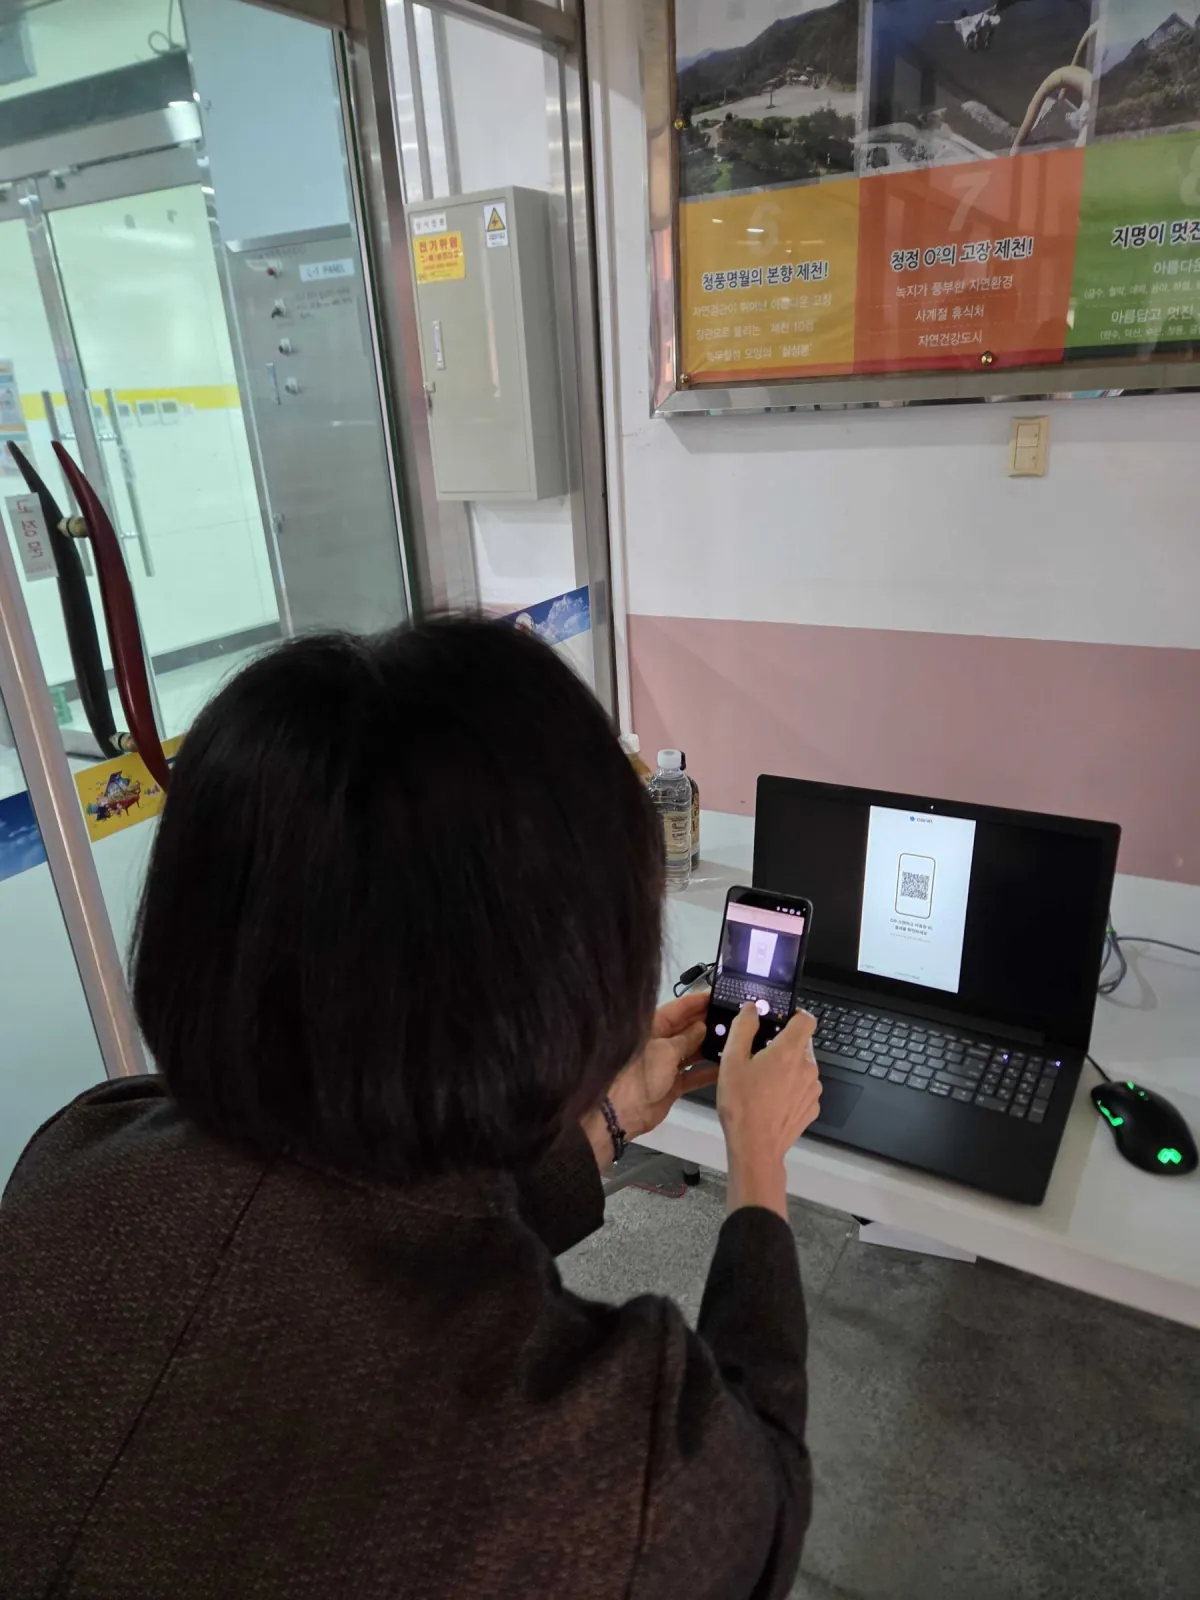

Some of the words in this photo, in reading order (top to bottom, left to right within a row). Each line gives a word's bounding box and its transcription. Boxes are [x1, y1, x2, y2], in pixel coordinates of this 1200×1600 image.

[1111, 223, 1165, 248] 지명이
[891, 249, 919, 270] 청정
[960, 241, 991, 261] 고장
[995, 236, 1034, 259] 제천!
[702, 267, 763, 291] 청풍명월의
[767, 263, 793, 285] 본향
[797, 260, 829, 281] 제천!
[896, 284, 929, 298] 녹지가
[931, 280, 966, 296] 풍부한
[970, 274, 1014, 291] 자연환경
[915, 307, 948, 322] 사계절
[951, 304, 985, 319] 휴식처
[1111, 307, 1161, 325] 아름답고
[1167, 304, 1194, 320] 멋진
[917, 329, 983, 347] 자연건강도시
